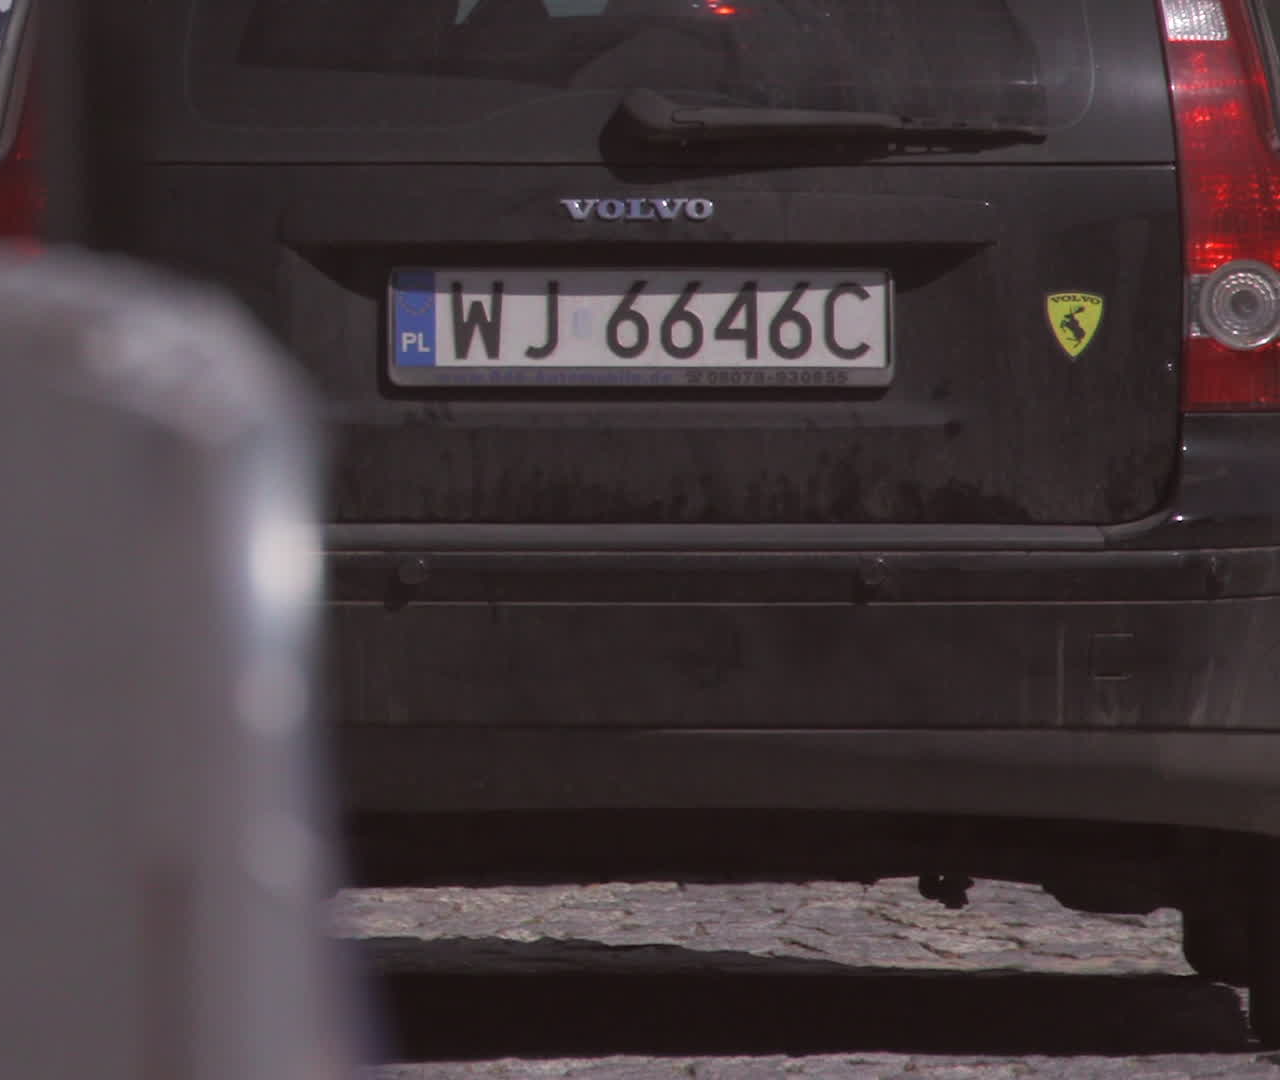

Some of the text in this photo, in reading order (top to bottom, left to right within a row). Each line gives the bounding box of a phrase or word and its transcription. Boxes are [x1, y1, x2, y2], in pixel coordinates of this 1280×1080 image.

[559, 198, 714, 220] VOLVO
[1050, 294, 1102, 305] VOLVO
[450, 279, 871, 360] WJ 6646C
[400, 331, 431, 353] PL
